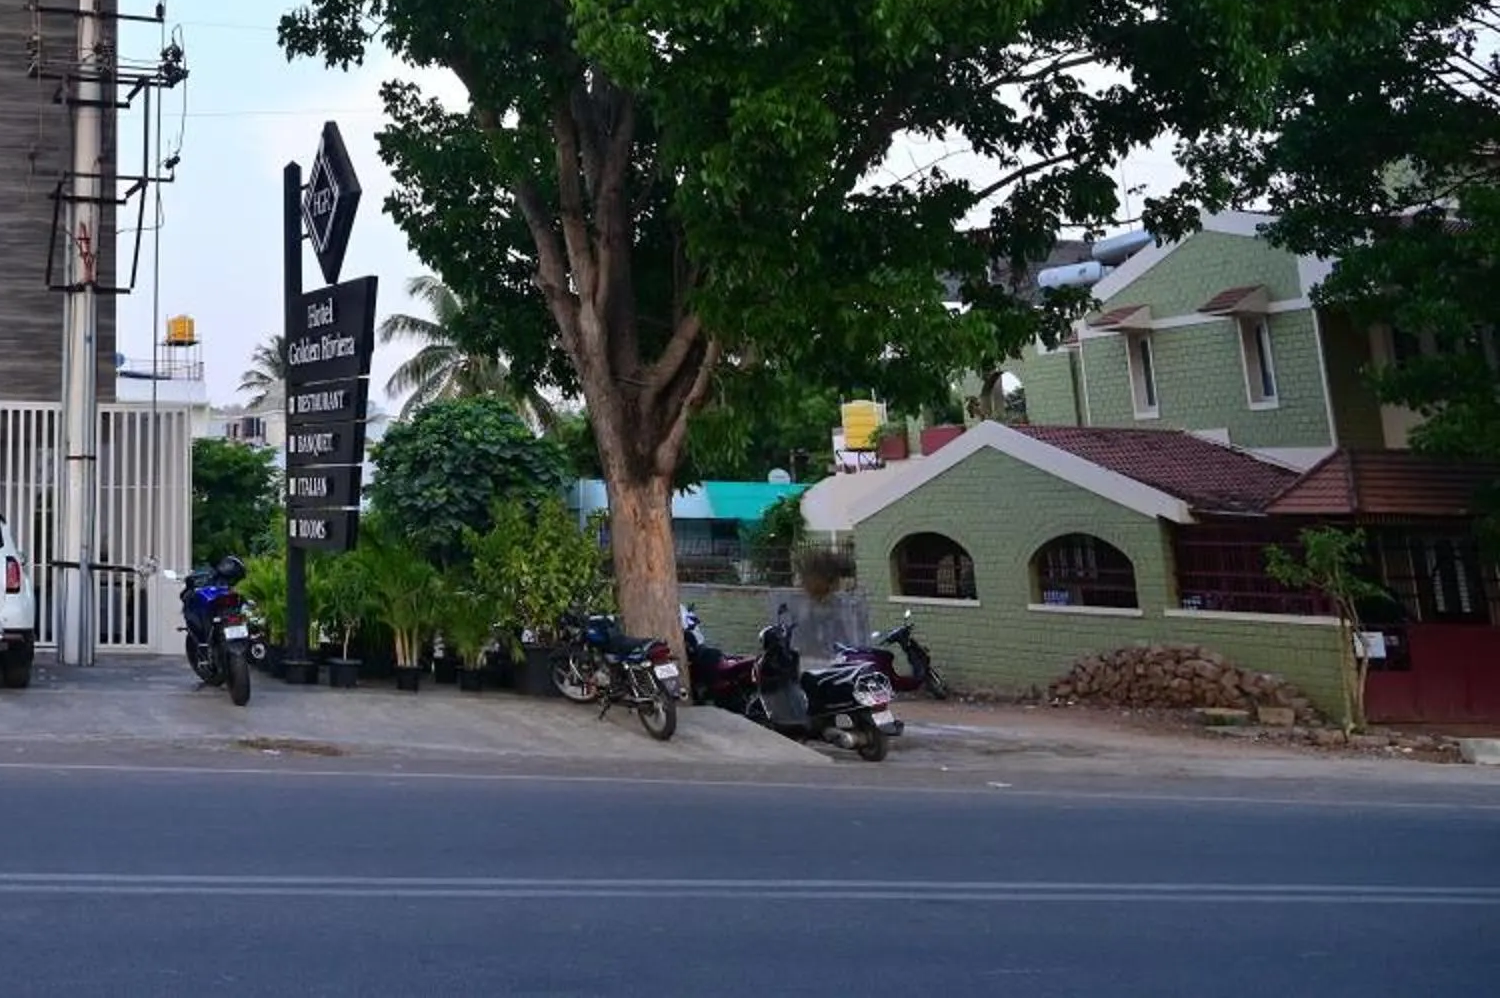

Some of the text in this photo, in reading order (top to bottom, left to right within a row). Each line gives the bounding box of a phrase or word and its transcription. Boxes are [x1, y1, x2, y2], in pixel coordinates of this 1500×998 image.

[307, 297, 333, 329] Hotel
[288, 331, 355, 366] Golden Riviera
[297, 389, 345, 414] RESTAURANT
[297, 433, 334, 457] BANQUET
[297, 476, 328, 497] ITALIAN
[298, 519, 327, 539] ROOMS
